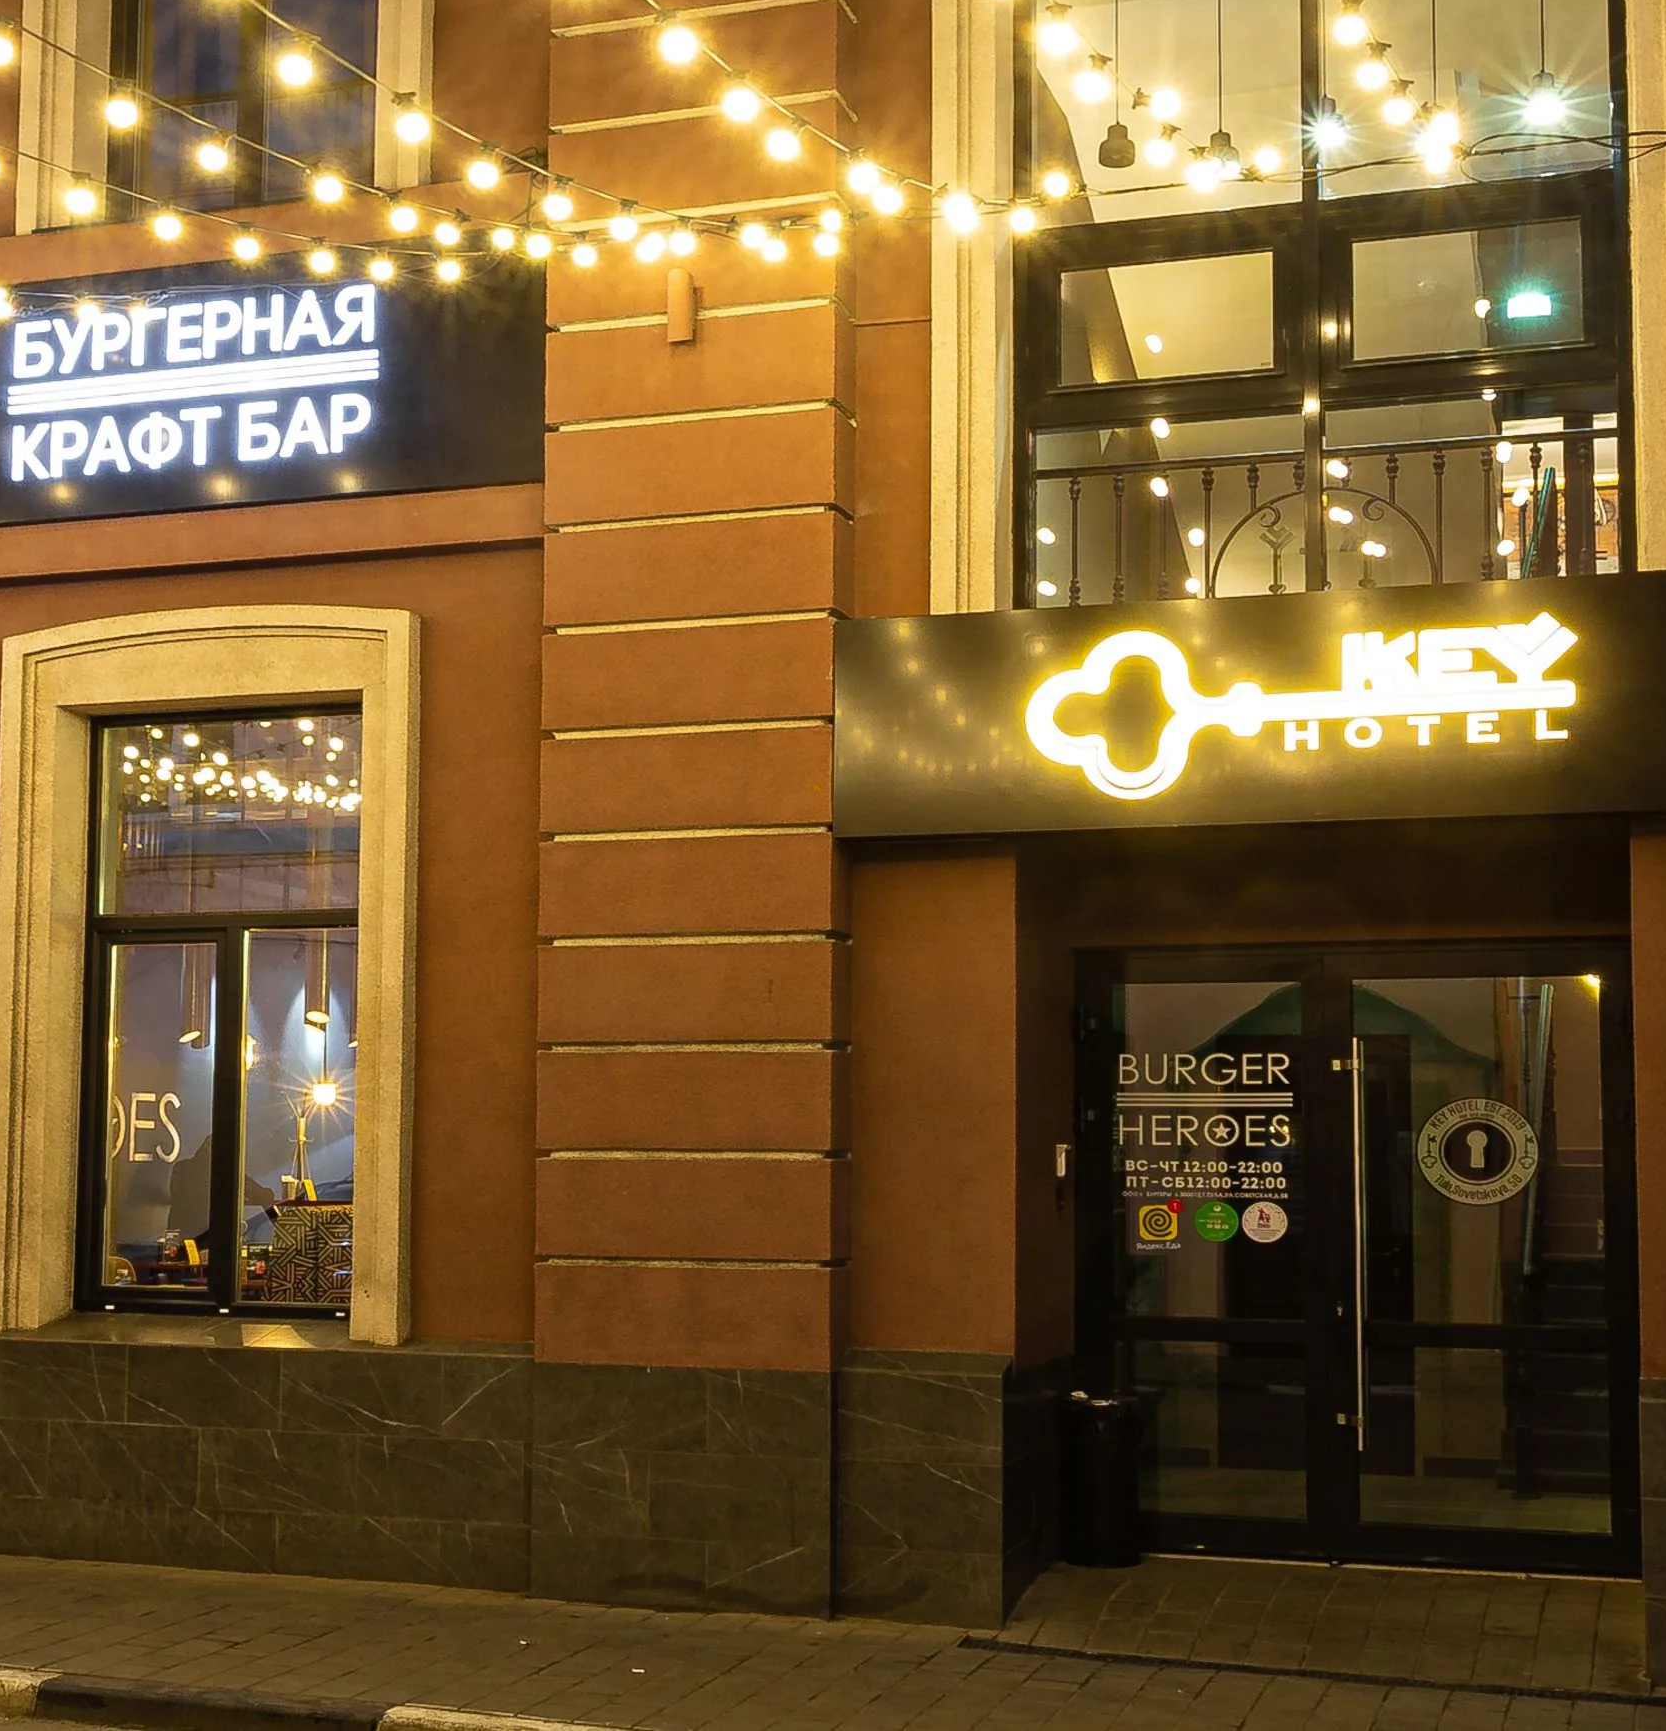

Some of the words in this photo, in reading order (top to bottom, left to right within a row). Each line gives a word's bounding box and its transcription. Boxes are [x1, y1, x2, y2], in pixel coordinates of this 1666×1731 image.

[11, 283, 377, 379] БУРГЕРНАЯ
[10, 405, 223, 482] КРАФТ
[237, 393, 372, 463] БАР
[1341, 611, 1579, 692] KEY
[1284, 709, 1569, 752] HOTEL
[1118, 1053, 1291, 1085] BURGER
[1118, 1114, 1291, 1147] HEROES
[1429, 1110, 1449, 1130] KEY
[1447, 1100, 1481, 1117] HOTEL
[1125, 1160, 1180, 1172] ВС-ЧТ
[1183, 1161, 1283, 1174] 12:00-22:00
